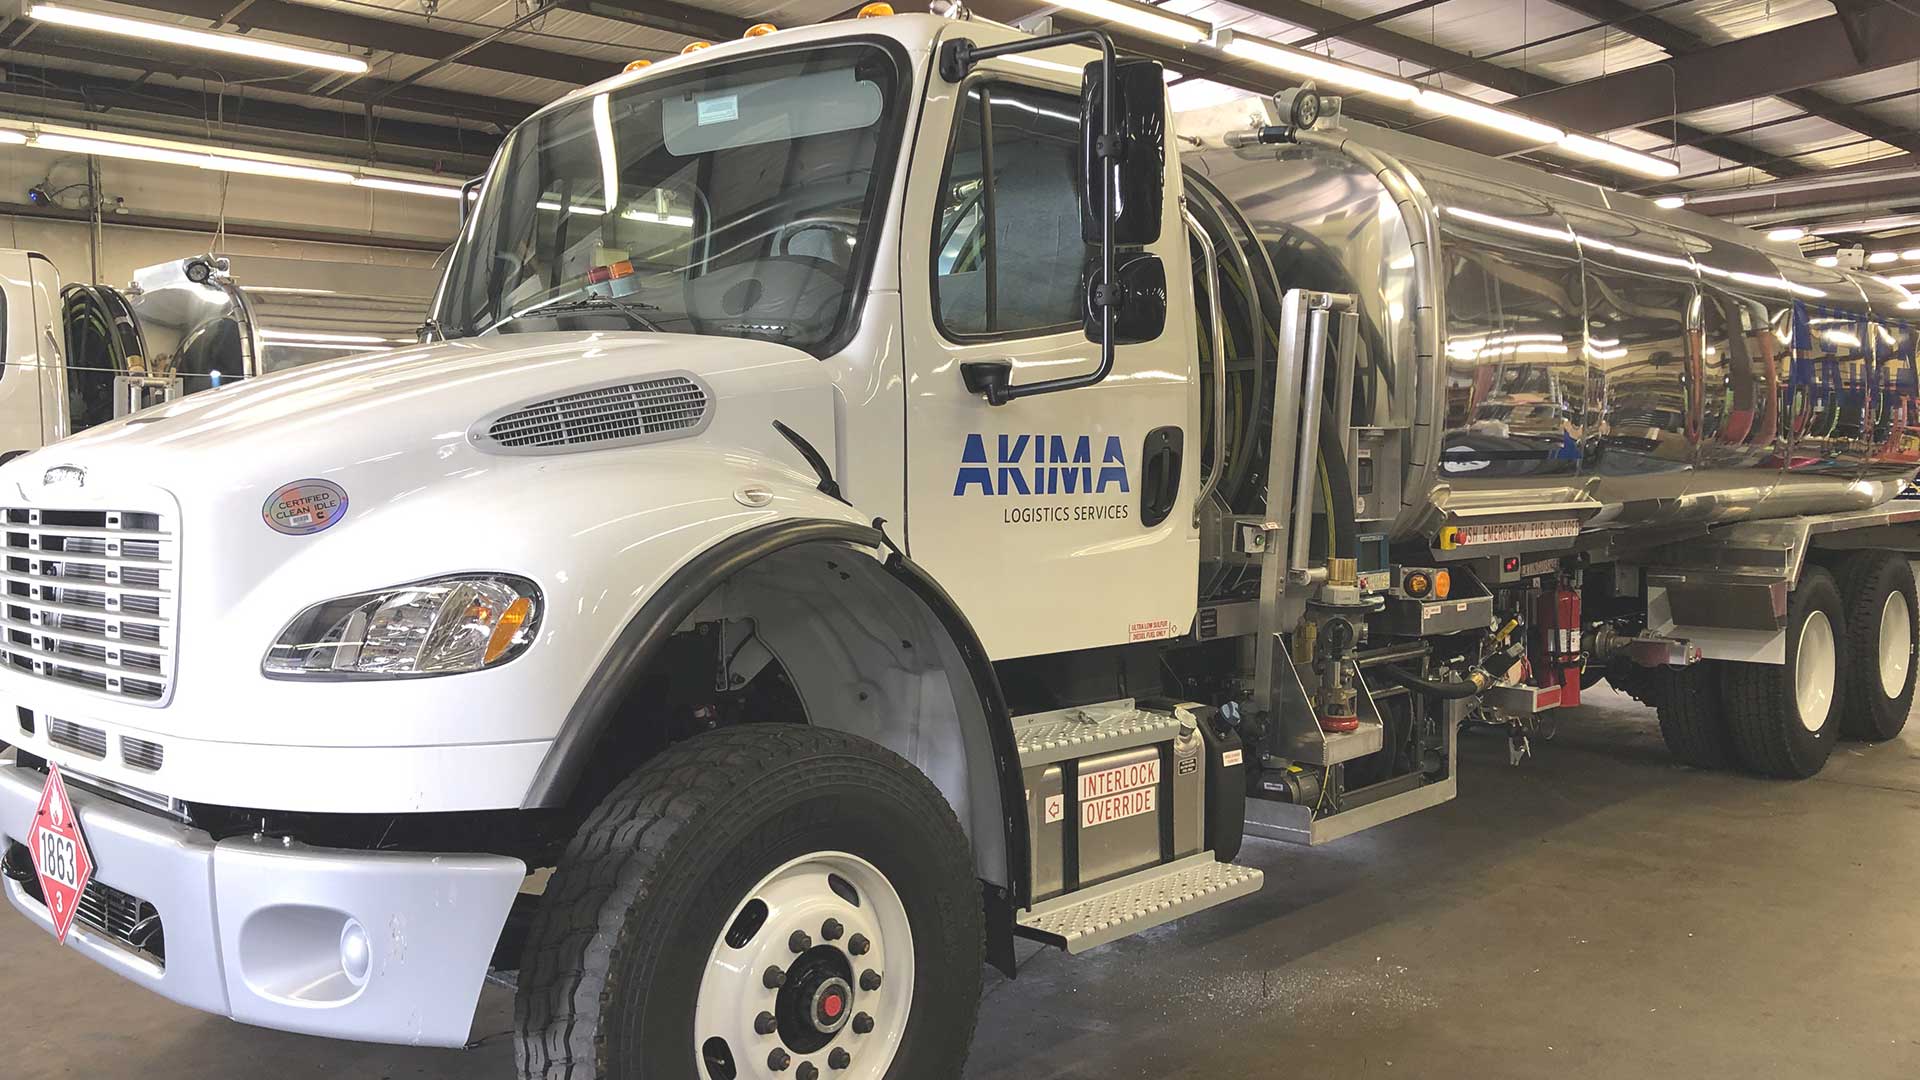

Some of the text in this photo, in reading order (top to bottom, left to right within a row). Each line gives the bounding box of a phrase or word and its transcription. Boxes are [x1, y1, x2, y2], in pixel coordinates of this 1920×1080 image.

[953, 434, 1130, 496] AKIMA
[276, 506, 310, 519] CLEAN
[314, 500, 336, 511] IDLE
[279, 493, 330, 510] CERTIFIED
[1004, 504, 1129, 523] LOGISTICS SERVICES
[1483, 523, 1527, 542] EMERGENCY
[1531, 522, 1547, 537] FUEL
[1551, 520, 1579, 536] SHUTOFF
[1083, 761, 1156, 798] INTERLOCK
[1086, 790, 1151, 825] OVERRIDE
[41, 831, 75, 885] 1863
[56, 890, 63, 913] 3
